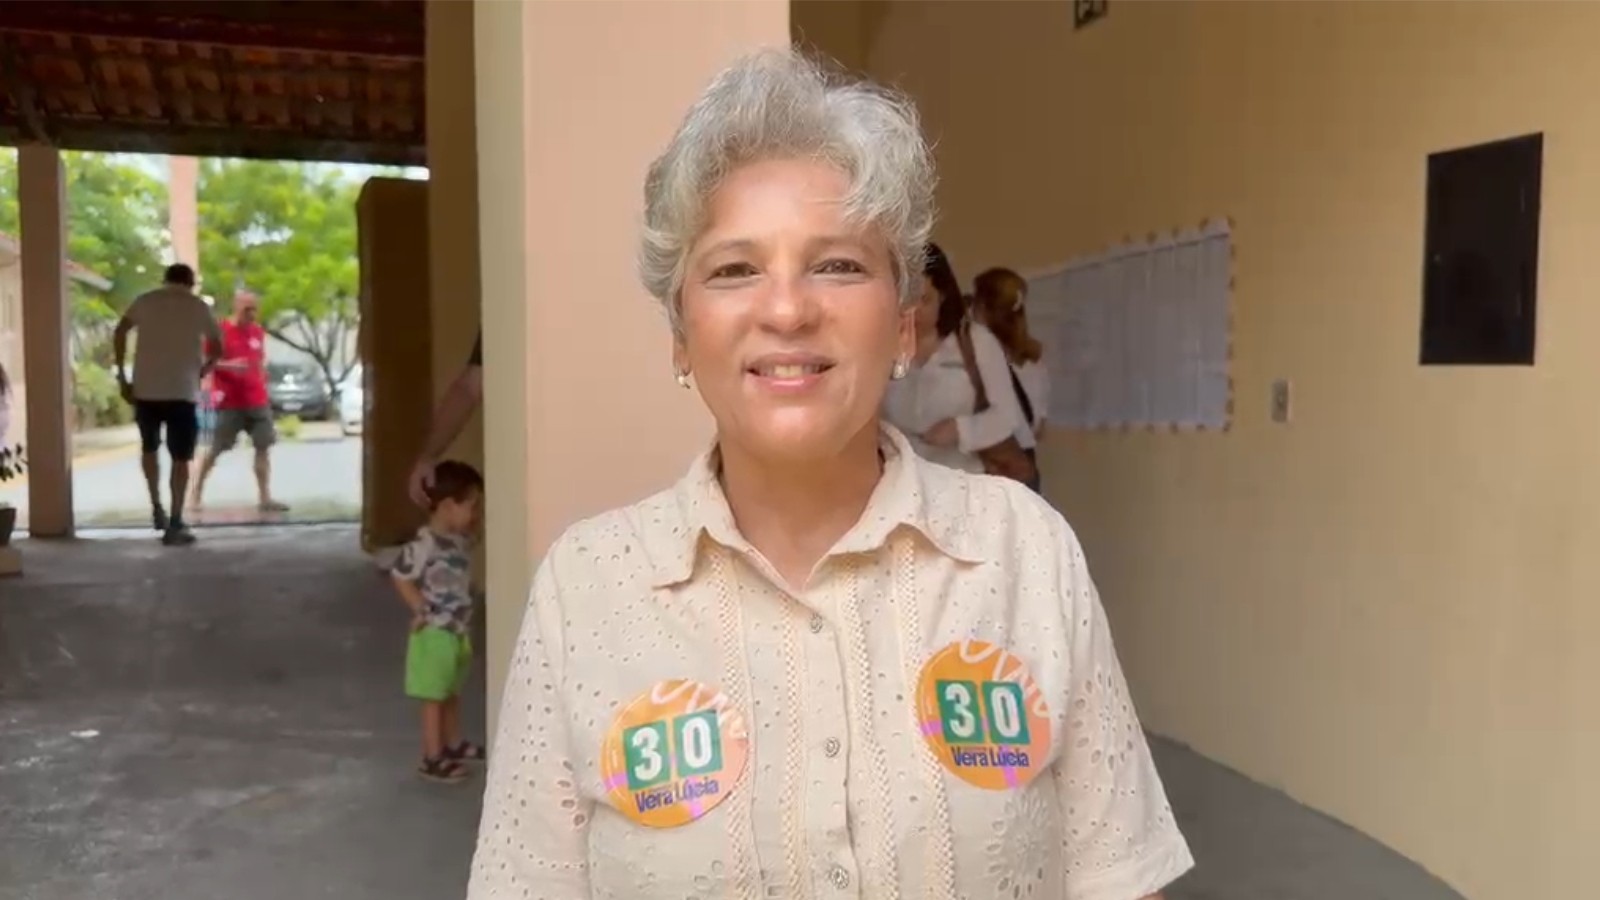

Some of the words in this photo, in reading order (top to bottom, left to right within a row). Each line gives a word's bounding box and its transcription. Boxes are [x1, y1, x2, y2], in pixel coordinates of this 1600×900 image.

[945, 682, 1021, 738] 30
[631, 716, 712, 781] 30
[951, 745, 989, 767] Vera
[634, 790, 673, 813] Vera
